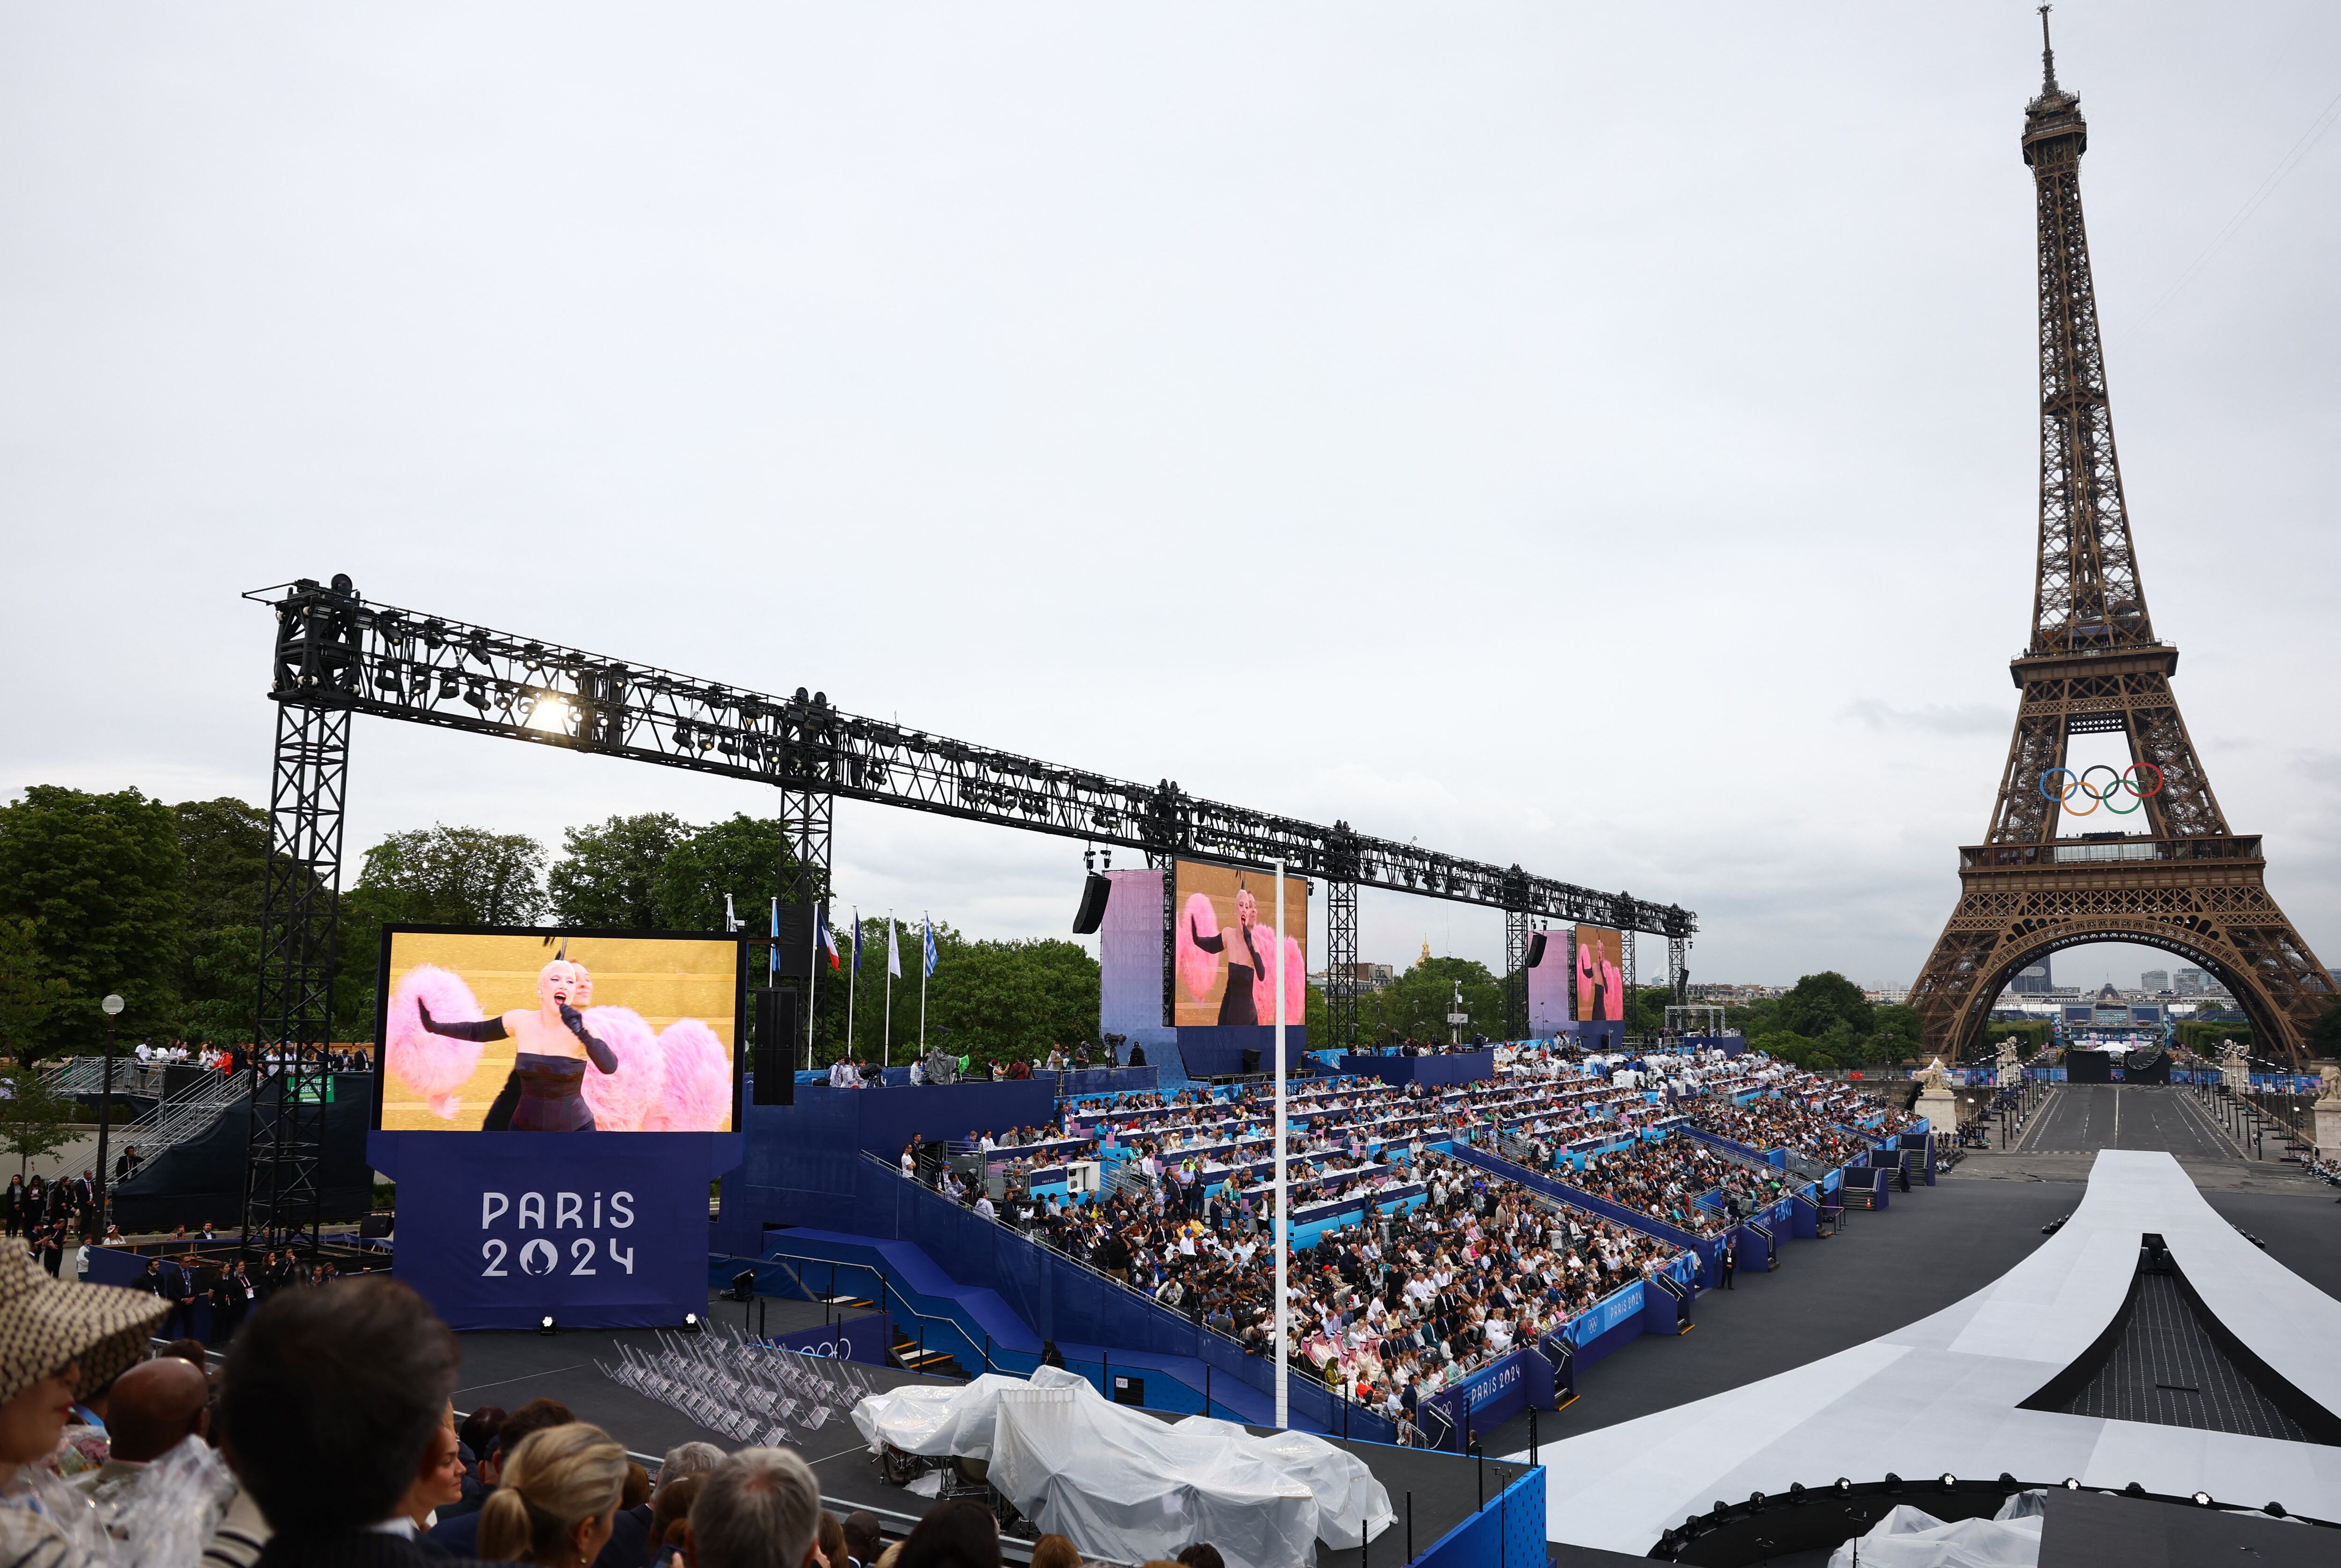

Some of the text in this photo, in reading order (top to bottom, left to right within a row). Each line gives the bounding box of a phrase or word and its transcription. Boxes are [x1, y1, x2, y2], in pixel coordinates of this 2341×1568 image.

[481, 1238, 633, 1277] 2024
[1628, 1291, 1642, 1309] 2024
[1499, 1364, 1520, 1389] 2024
